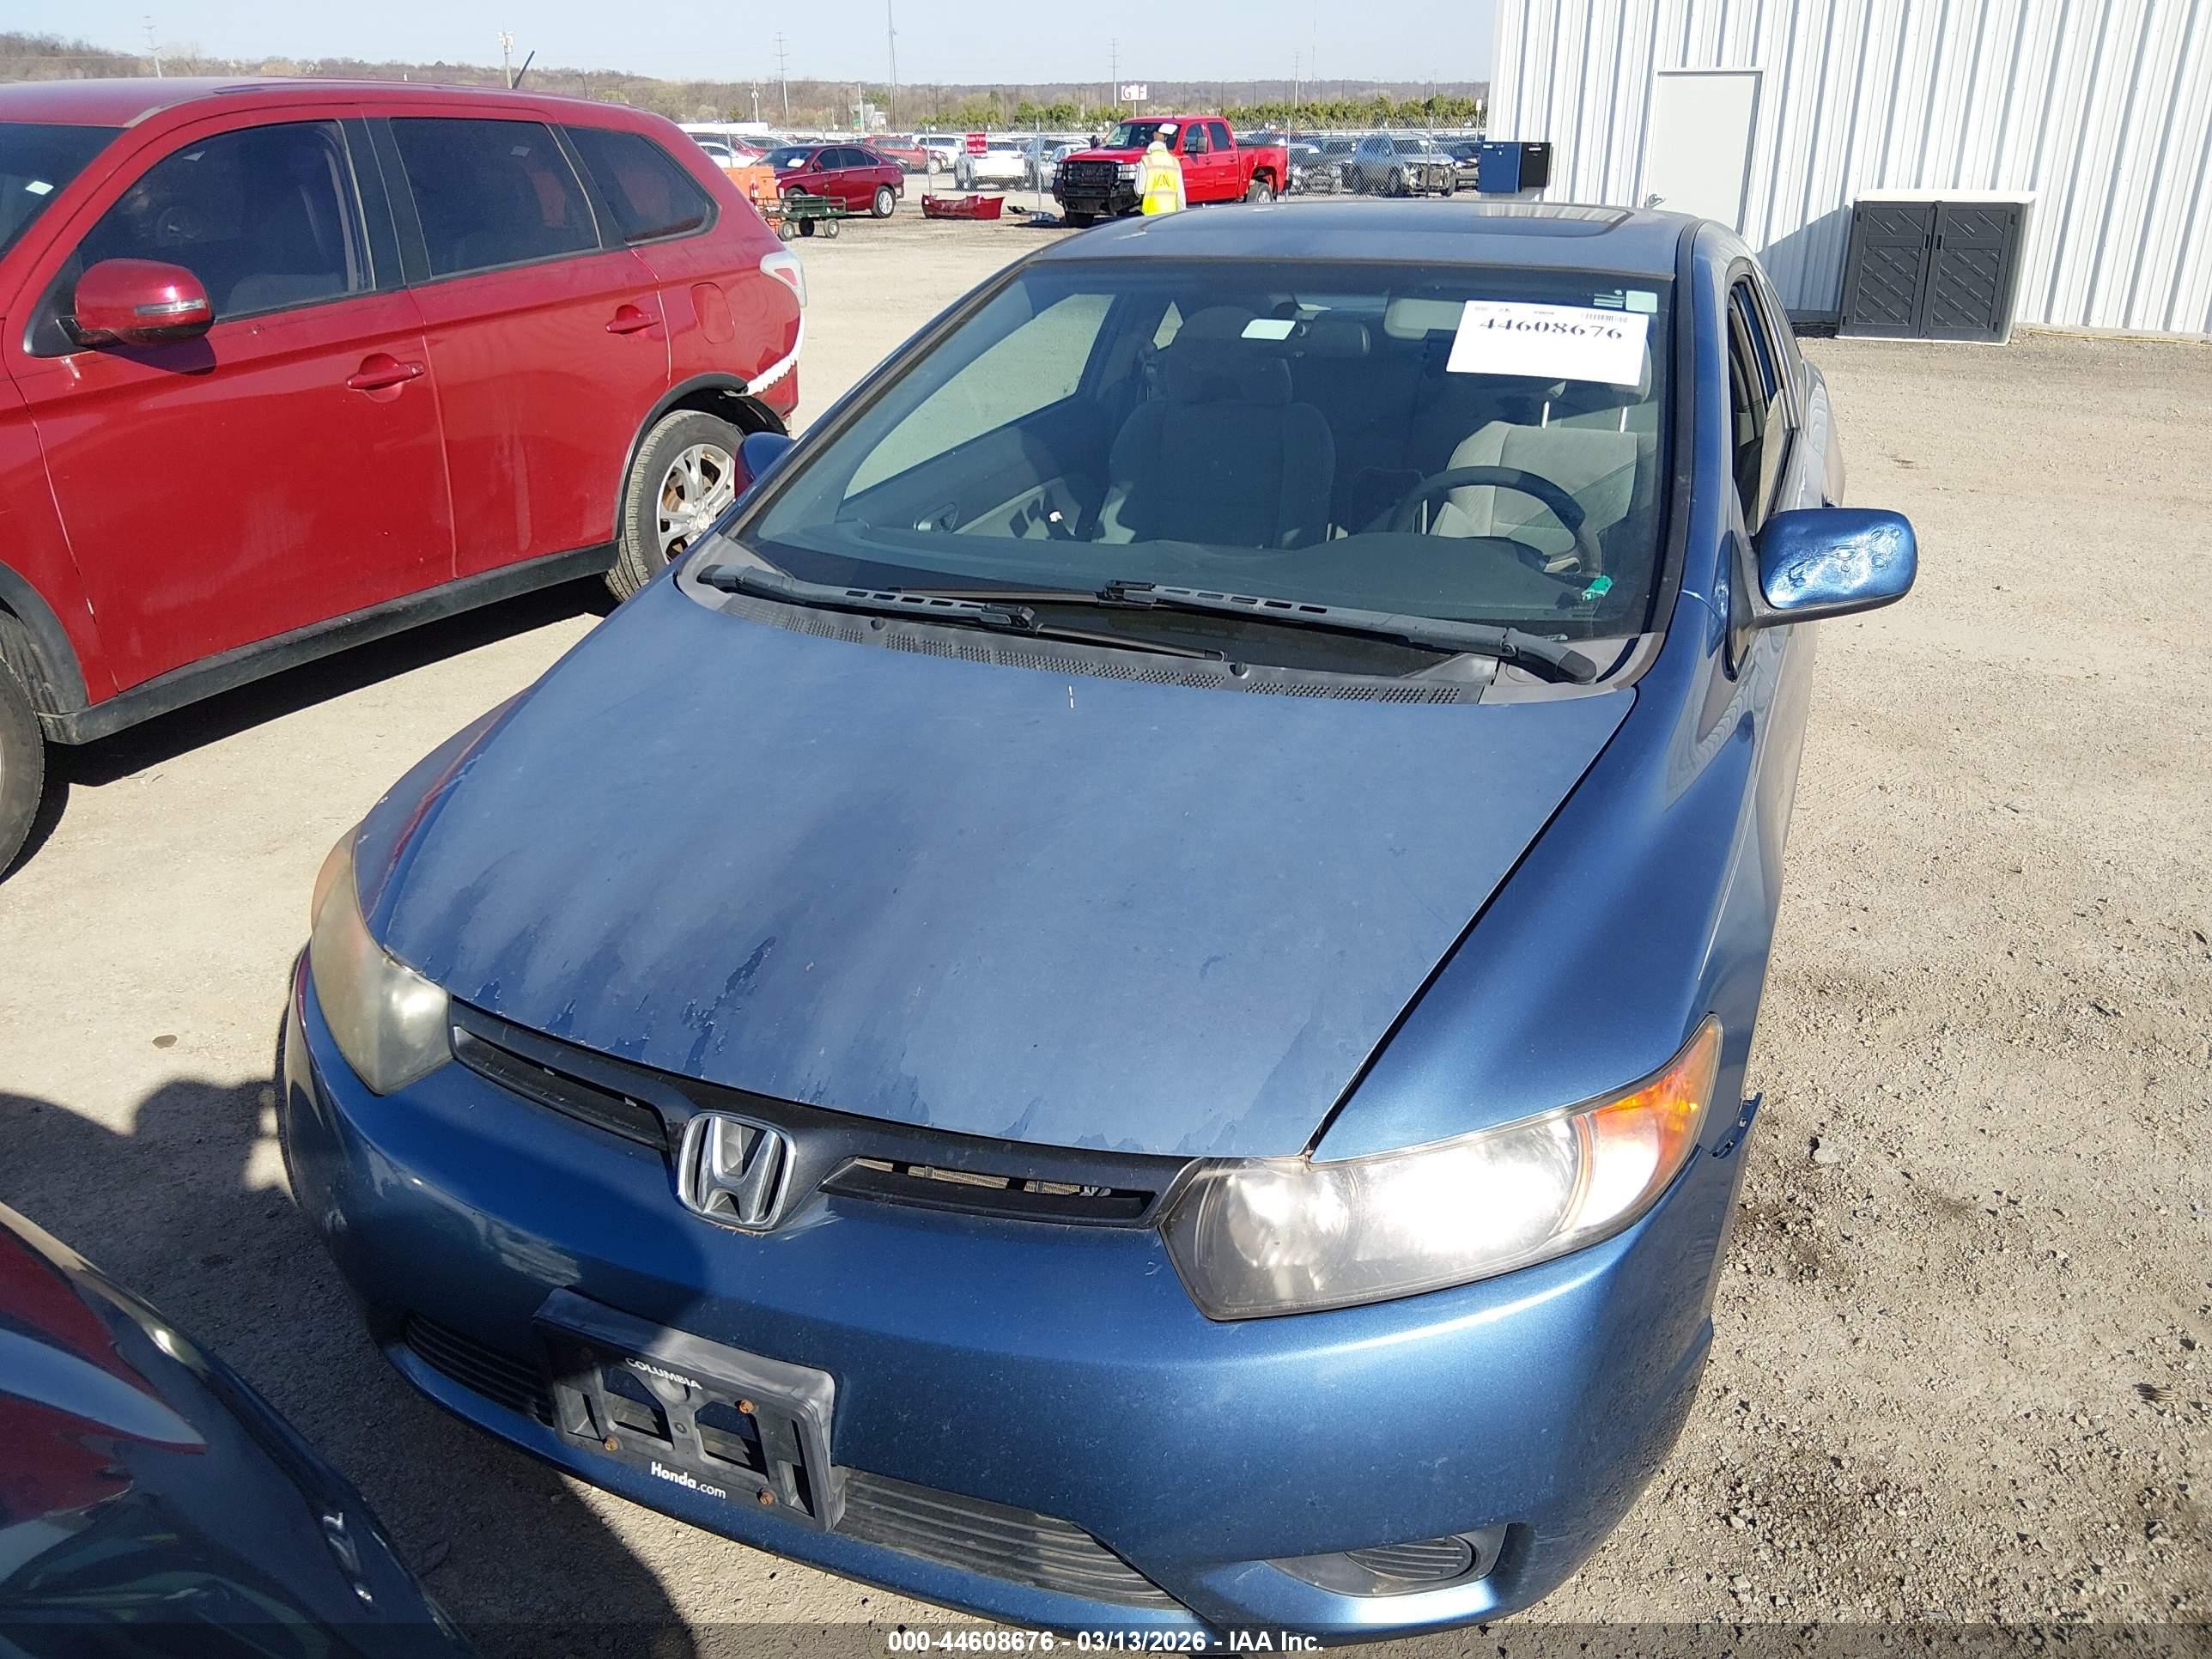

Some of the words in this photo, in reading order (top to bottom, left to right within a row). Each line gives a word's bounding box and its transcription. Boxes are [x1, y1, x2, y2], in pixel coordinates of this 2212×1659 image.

[1479, 317, 1623, 339] 44608676
[625, 1358, 702, 1389] COLUMBIA
[651, 1461, 726, 1499] Honda.com
